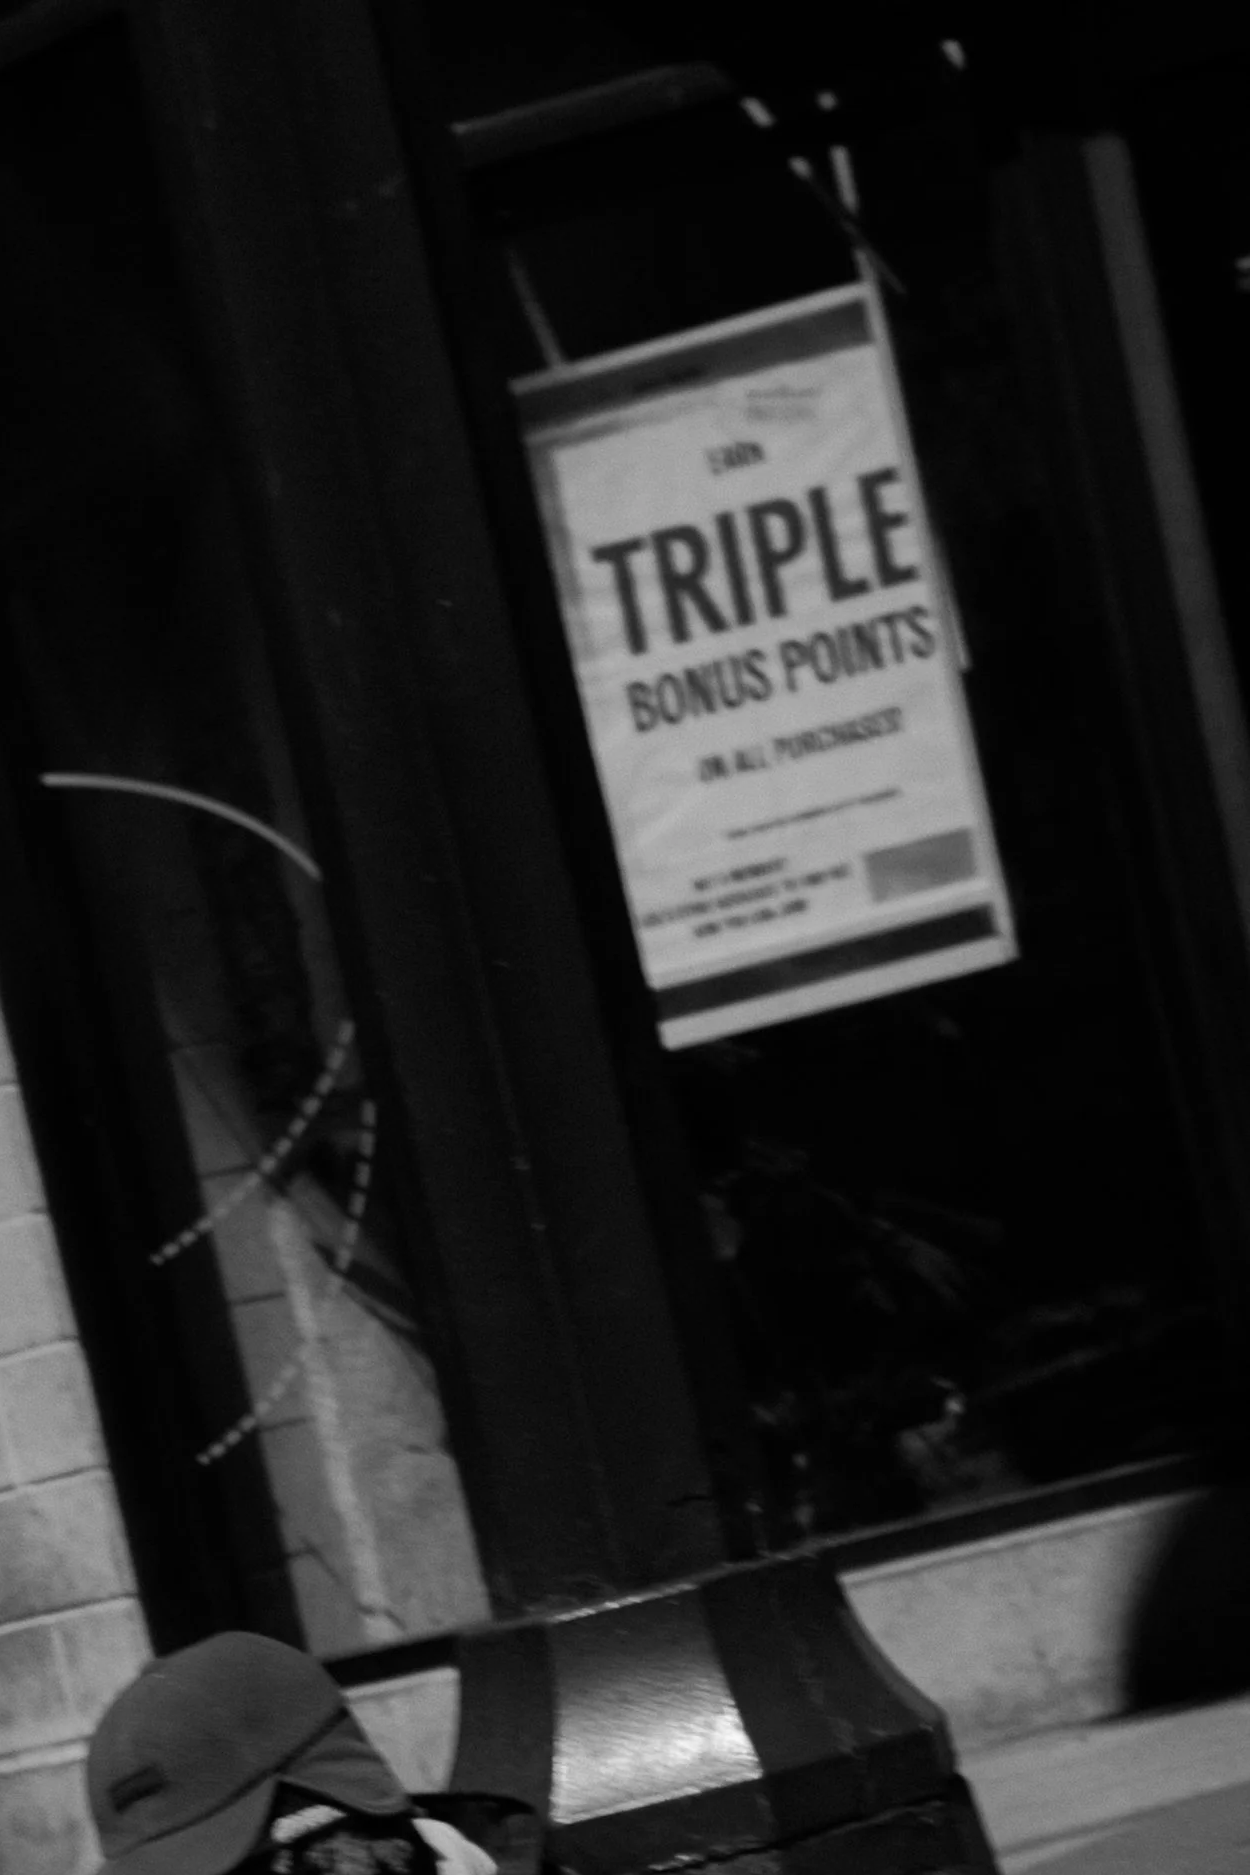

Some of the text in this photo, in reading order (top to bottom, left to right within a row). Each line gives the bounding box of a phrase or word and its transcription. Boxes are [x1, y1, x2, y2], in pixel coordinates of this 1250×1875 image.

[590, 467, 919, 656] TRIPLE
[626, 605, 936, 733] BONUS POINTS
